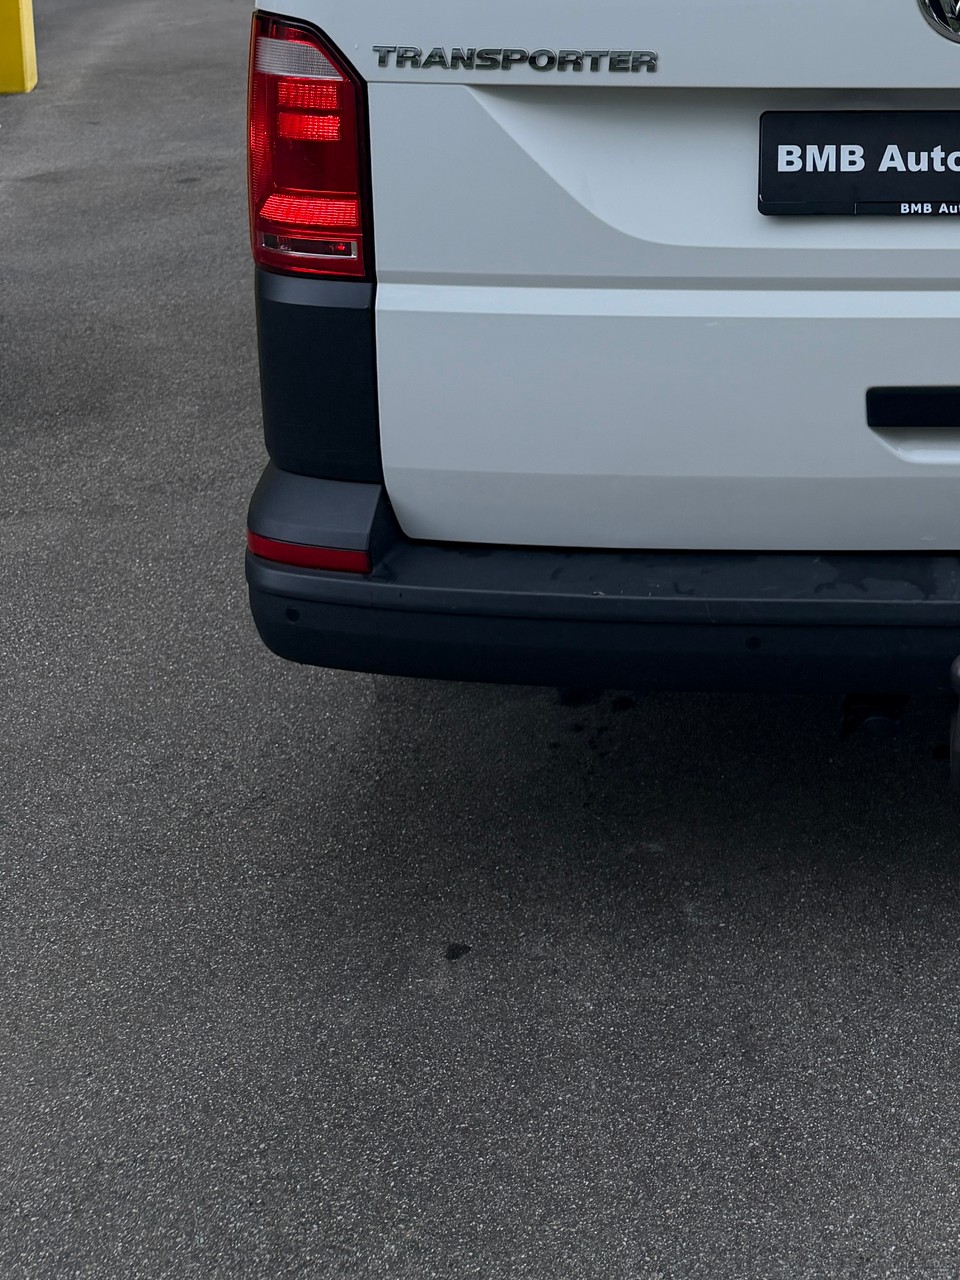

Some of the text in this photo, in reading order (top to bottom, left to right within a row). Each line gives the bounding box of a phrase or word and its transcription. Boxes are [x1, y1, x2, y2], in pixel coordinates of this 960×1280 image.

[372, 45, 658, 73] TRANSPORTER
[777, 144, 866, 172] BMB
[900, 203, 933, 214] BMB
